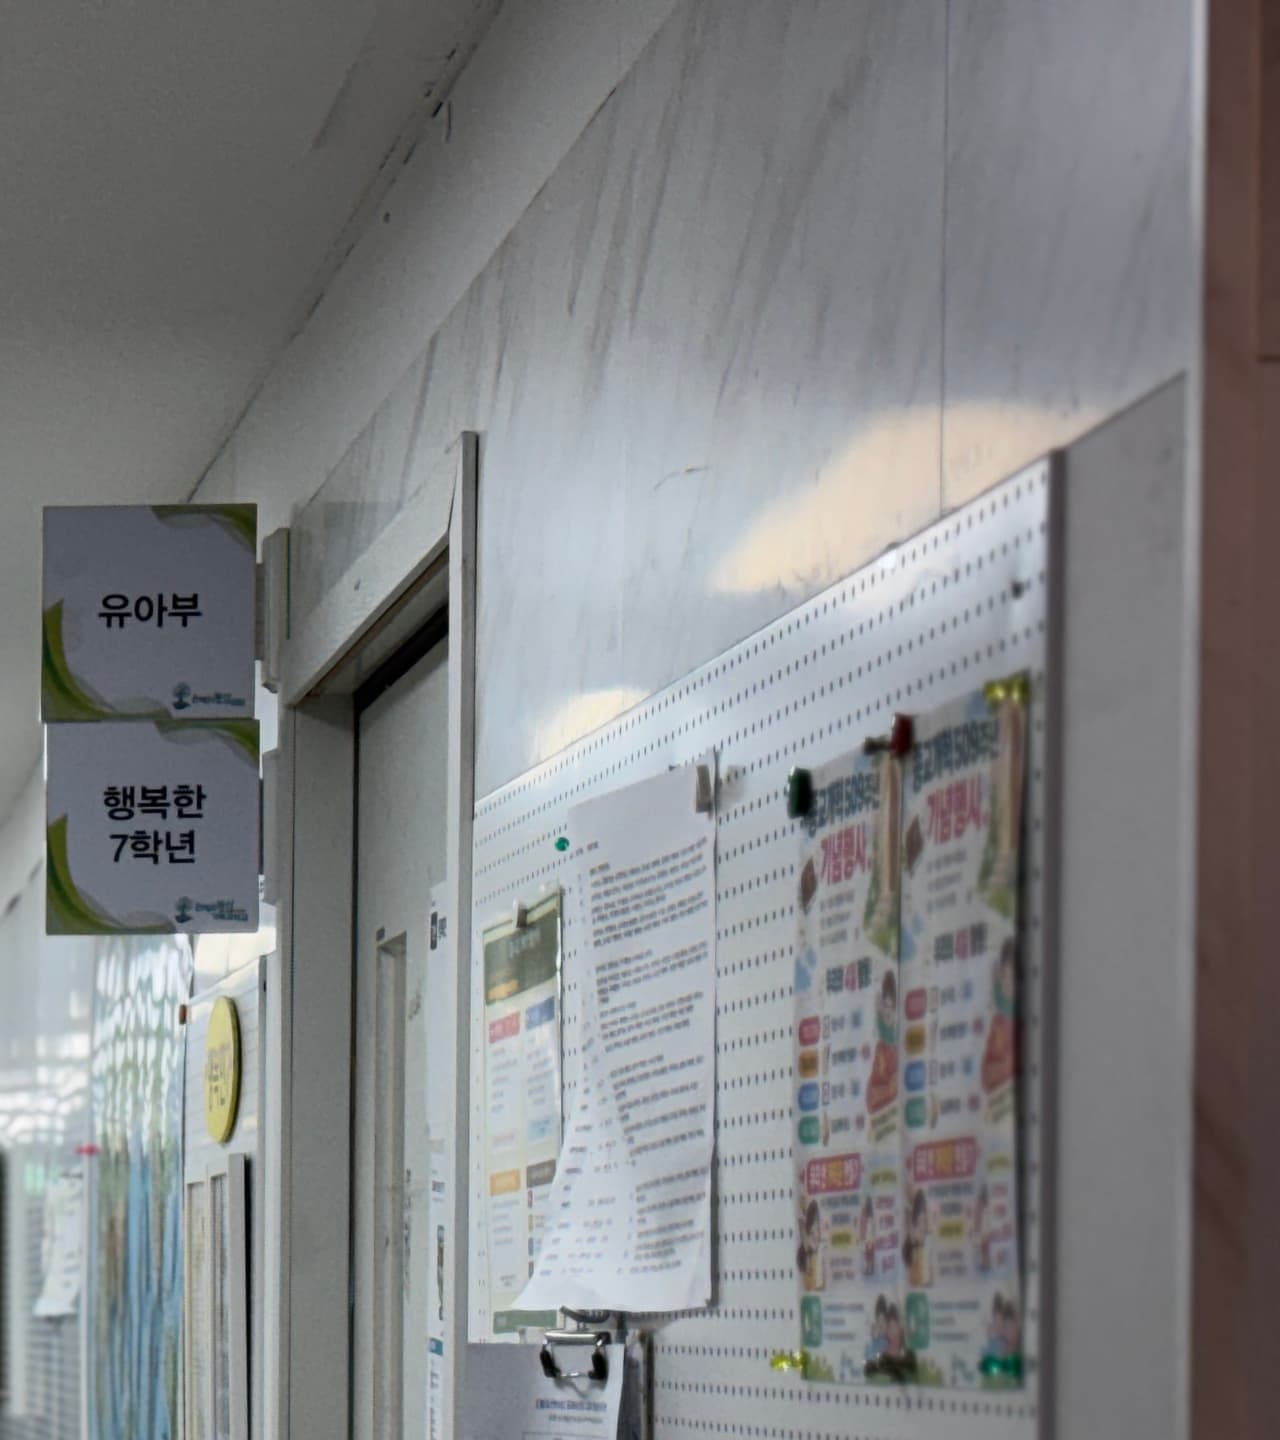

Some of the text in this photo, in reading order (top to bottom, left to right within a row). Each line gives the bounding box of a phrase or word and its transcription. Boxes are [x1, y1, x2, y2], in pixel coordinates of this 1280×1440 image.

[98, 593, 203, 629] 유아부
[103, 784, 207, 821] 행복한
[109, 829, 196, 866] 7학년
